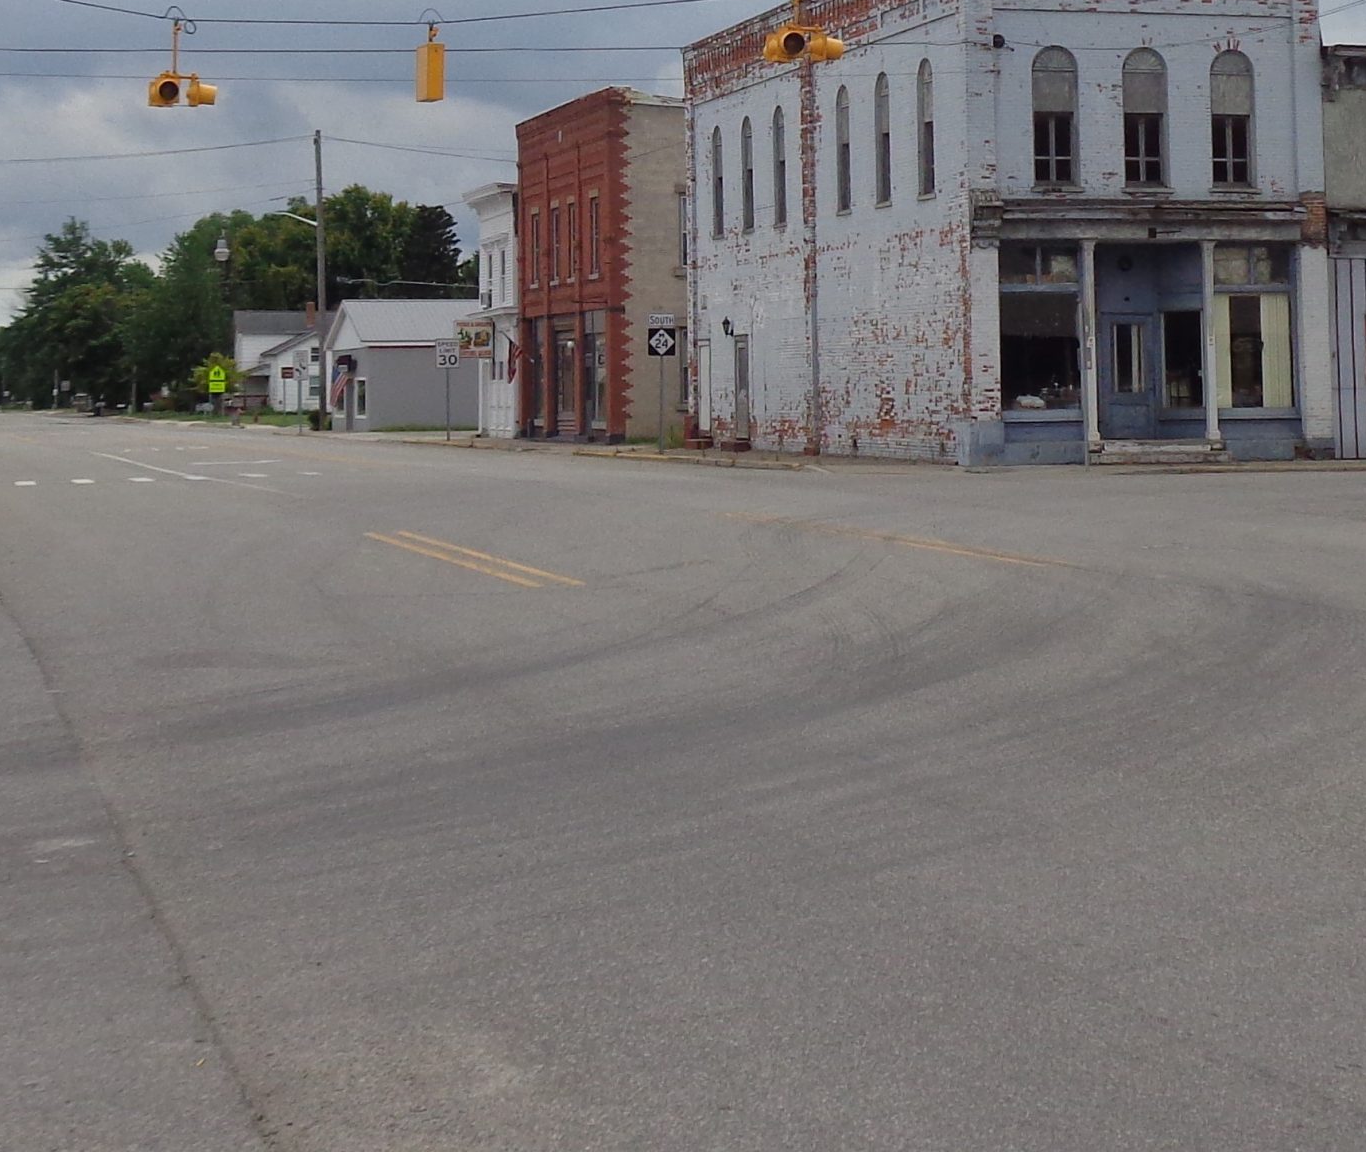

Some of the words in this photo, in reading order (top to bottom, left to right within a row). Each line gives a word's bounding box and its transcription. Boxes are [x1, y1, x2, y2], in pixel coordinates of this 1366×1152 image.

[649, 315, 674, 325] SOUTH
[654, 338, 668, 349] 24
[438, 354, 458, 366] 30
